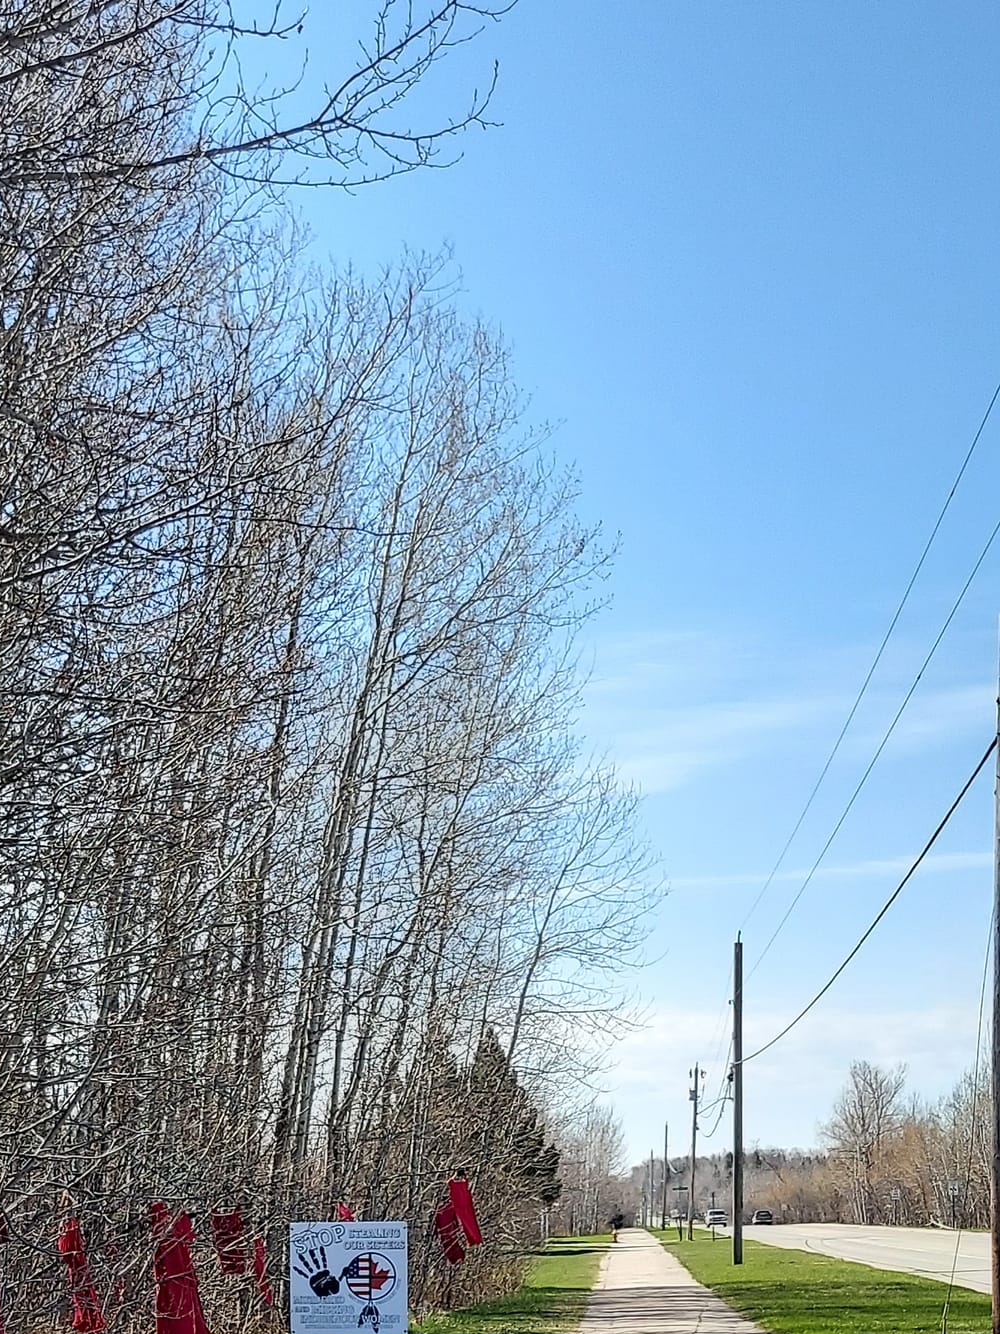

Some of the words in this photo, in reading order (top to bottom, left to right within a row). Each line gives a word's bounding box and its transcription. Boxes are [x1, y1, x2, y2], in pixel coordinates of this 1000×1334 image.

[293, 1224, 345, 1254] STOP
[349, 1229, 401, 1239] STEALING
[344, 1240, 364, 1250] OUR
[366, 1241, 405, 1250] SISTERS
[361, 1314, 401, 1324] WOMEN
